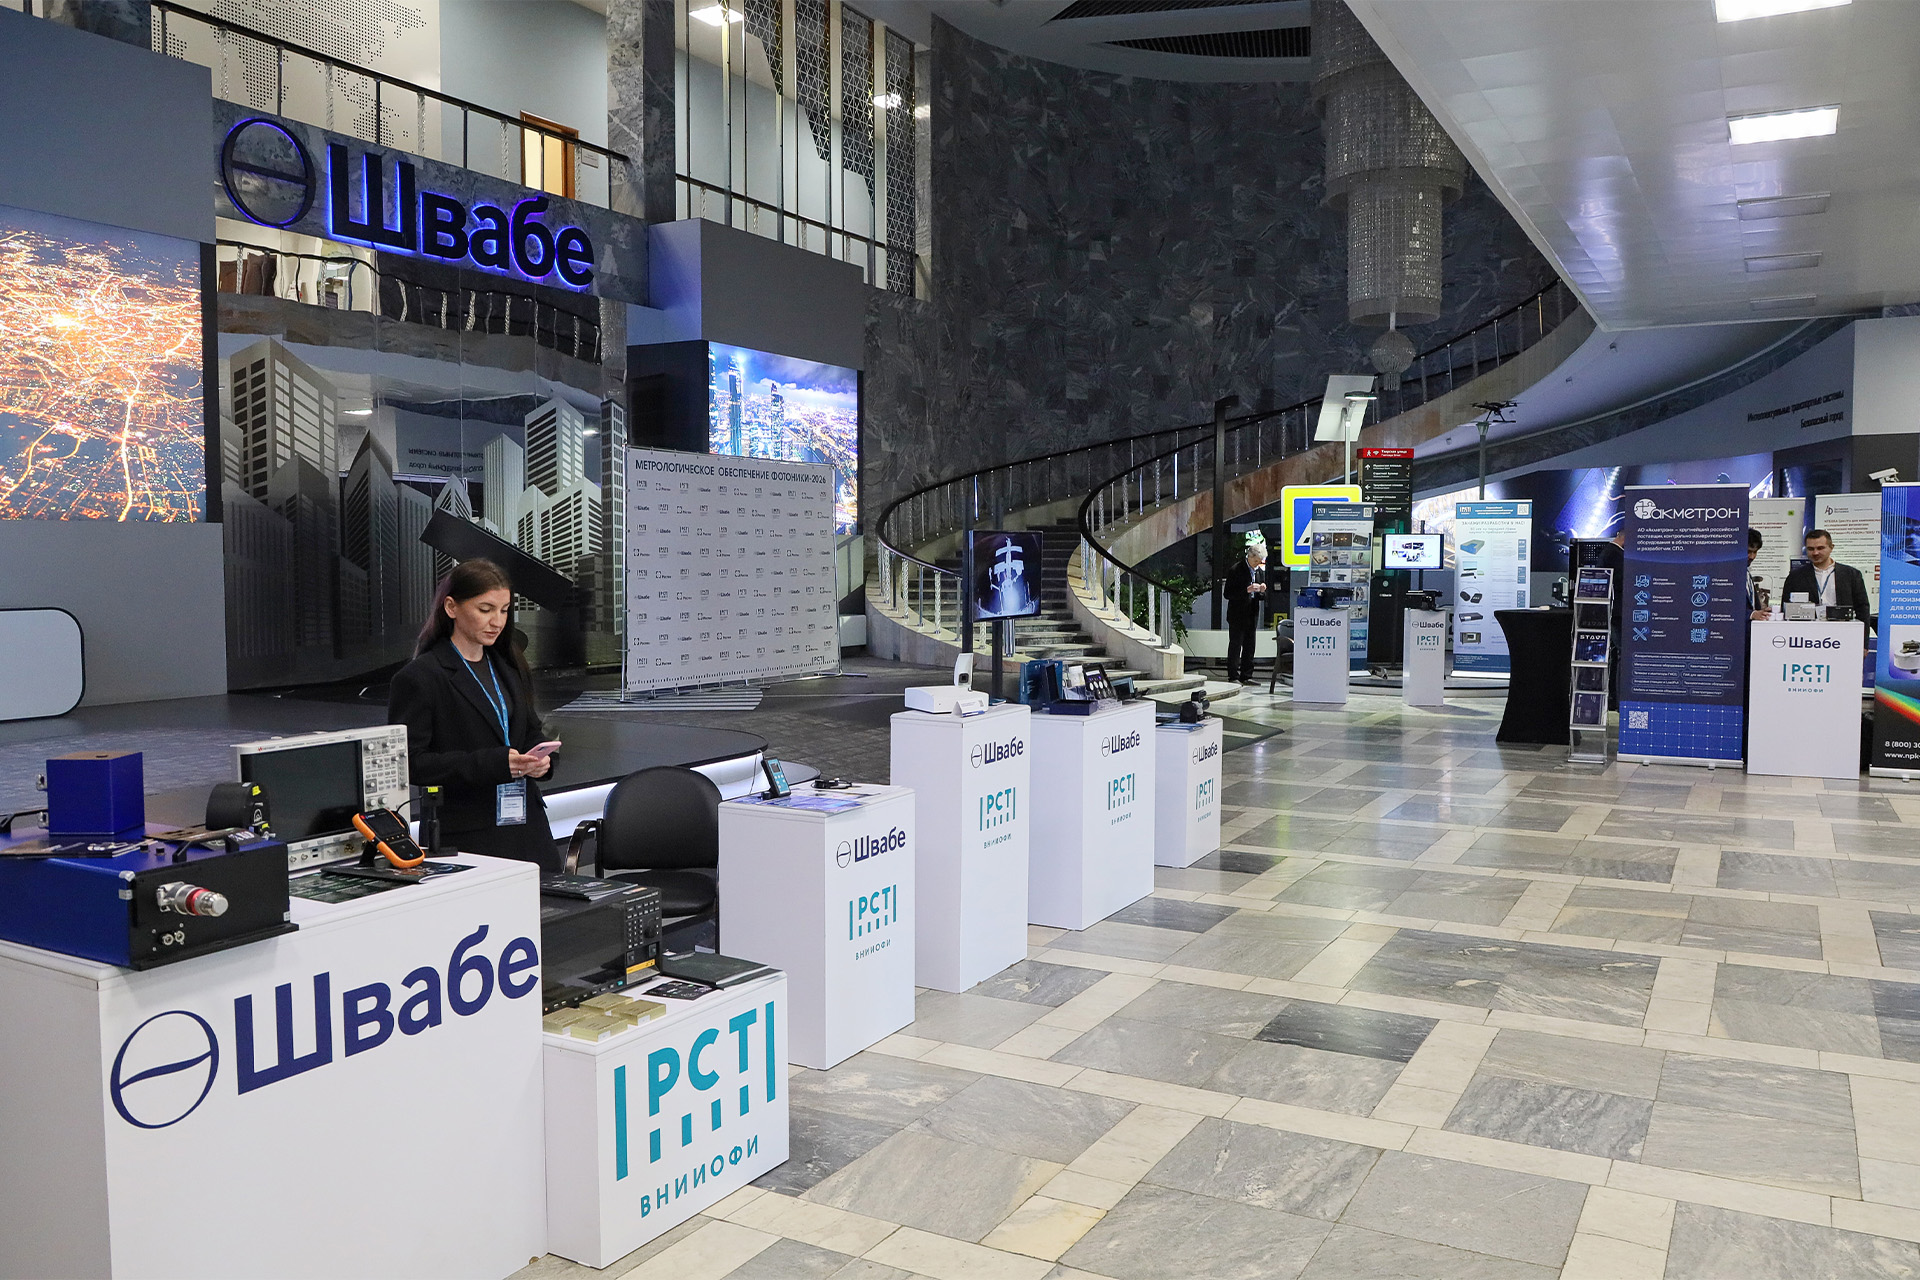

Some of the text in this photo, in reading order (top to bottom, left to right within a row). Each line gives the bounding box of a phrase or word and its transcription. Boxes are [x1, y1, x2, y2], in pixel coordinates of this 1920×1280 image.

[328, 142, 595, 287] Швабе
[635, 460, 826, 484] МЕТРОЛОГИЧЕСКОЕ ОБЕСПЕЧЕНИЕ ФОТОНИКИ-2026
[1652, 507, 1740, 521] акметрон
[1310, 618, 1342, 627] Швабе
[1789, 636, 1841, 649] Швабе
[984, 736, 1024, 764] Швабе
[1111, 730, 1140, 754] Швабе
[1198, 741, 1218, 762] Швабе
[854, 826, 906, 862] Швабе
[855, 939, 891, 961] ВНИИОФИ
[234, 924, 539, 1096] Швабе
[640, 1134, 758, 1218] ВНИИОФИ
